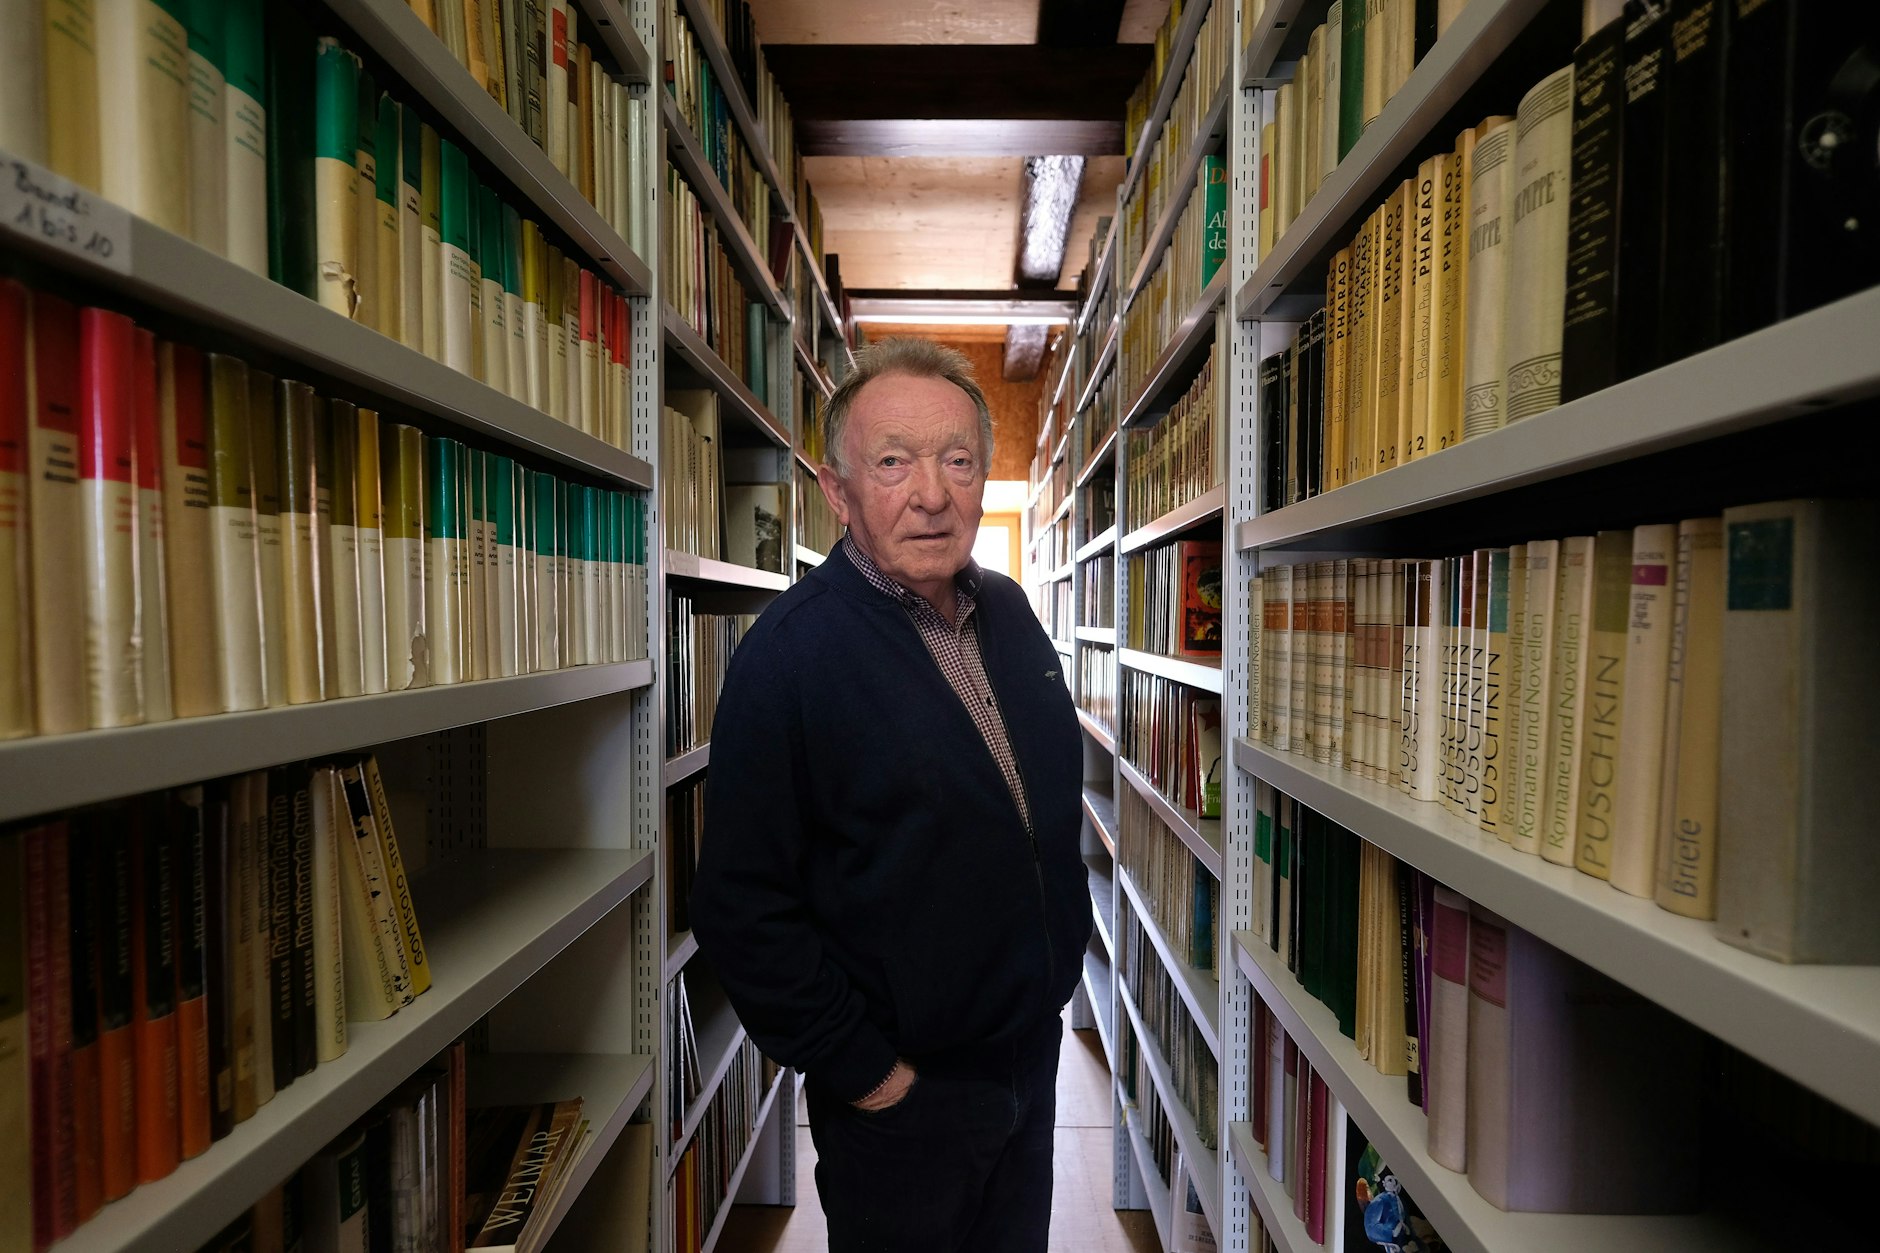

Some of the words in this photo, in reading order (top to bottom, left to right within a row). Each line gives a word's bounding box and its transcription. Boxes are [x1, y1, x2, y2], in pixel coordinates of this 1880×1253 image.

[40, 208, 78, 243] bis
[1419, 178, 1432, 277] PHARAO
[1442, 172, 1453, 272] PHARAO
[1454, 154, 1463, 230] PHARAO
[1353, 245, 1362, 326] PHARAO
[1359, 235, 1368, 319] PHARAO
[1383, 213, 1394, 303] PHARAO
[1393, 203, 1403, 295] PHARAO
[1327, 268, 1336, 345] PHARAO
[1336, 261, 1347, 340] PHARAO
[1382, 308, 1391, 332] Prus
[1418, 282, 1430, 309] Prus
[1442, 278, 1452, 307] Prus
[1336, 344, 1345, 368] Prus
[1335, 468, 1340, 480] 1
[1379, 449, 1385, 463] 2
[1390, 446, 1396, 459] 2
[1416, 435, 1425, 451] 2
[1440, 436, 1448, 450] 2
[1251, 614, 1260, 662] Novellen
[1252, 664, 1260, 685] und
[1508, 611, 1525, 701] Novellen
[1525, 613, 1544, 706] Novellen
[1558, 612, 1580, 710] Novellen
[1252, 687, 1260, 732] Romane
[1454, 643, 1469, 806] PUSCHKIN
[1465, 647, 1483, 816] PUSCHKIN
[1480, 651, 1501, 828] PUSCHKIN
[1506, 702, 1520, 743] und
[1521, 711, 1539, 750] und
[1556, 715, 1574, 758] und
[1503, 747, 1519, 827] Romane
[1518, 754, 1539, 838] Romane
[1582, 654, 1620, 869] PUSCHKIN
[372, 772, 399, 867] STRANDGUT
[1548, 761, 1570, 850] Romane
[1672, 818, 1700, 899] Briefe
[396, 875, 424, 967] GOYTISOLO
[1399, 878, 1409, 925] RELIQUIE
[1401, 929, 1409, 946] DIE
[1401, 950, 1411, 1004] QUEIROZ,
[479, 1126, 566, 1233] WEIMAR
